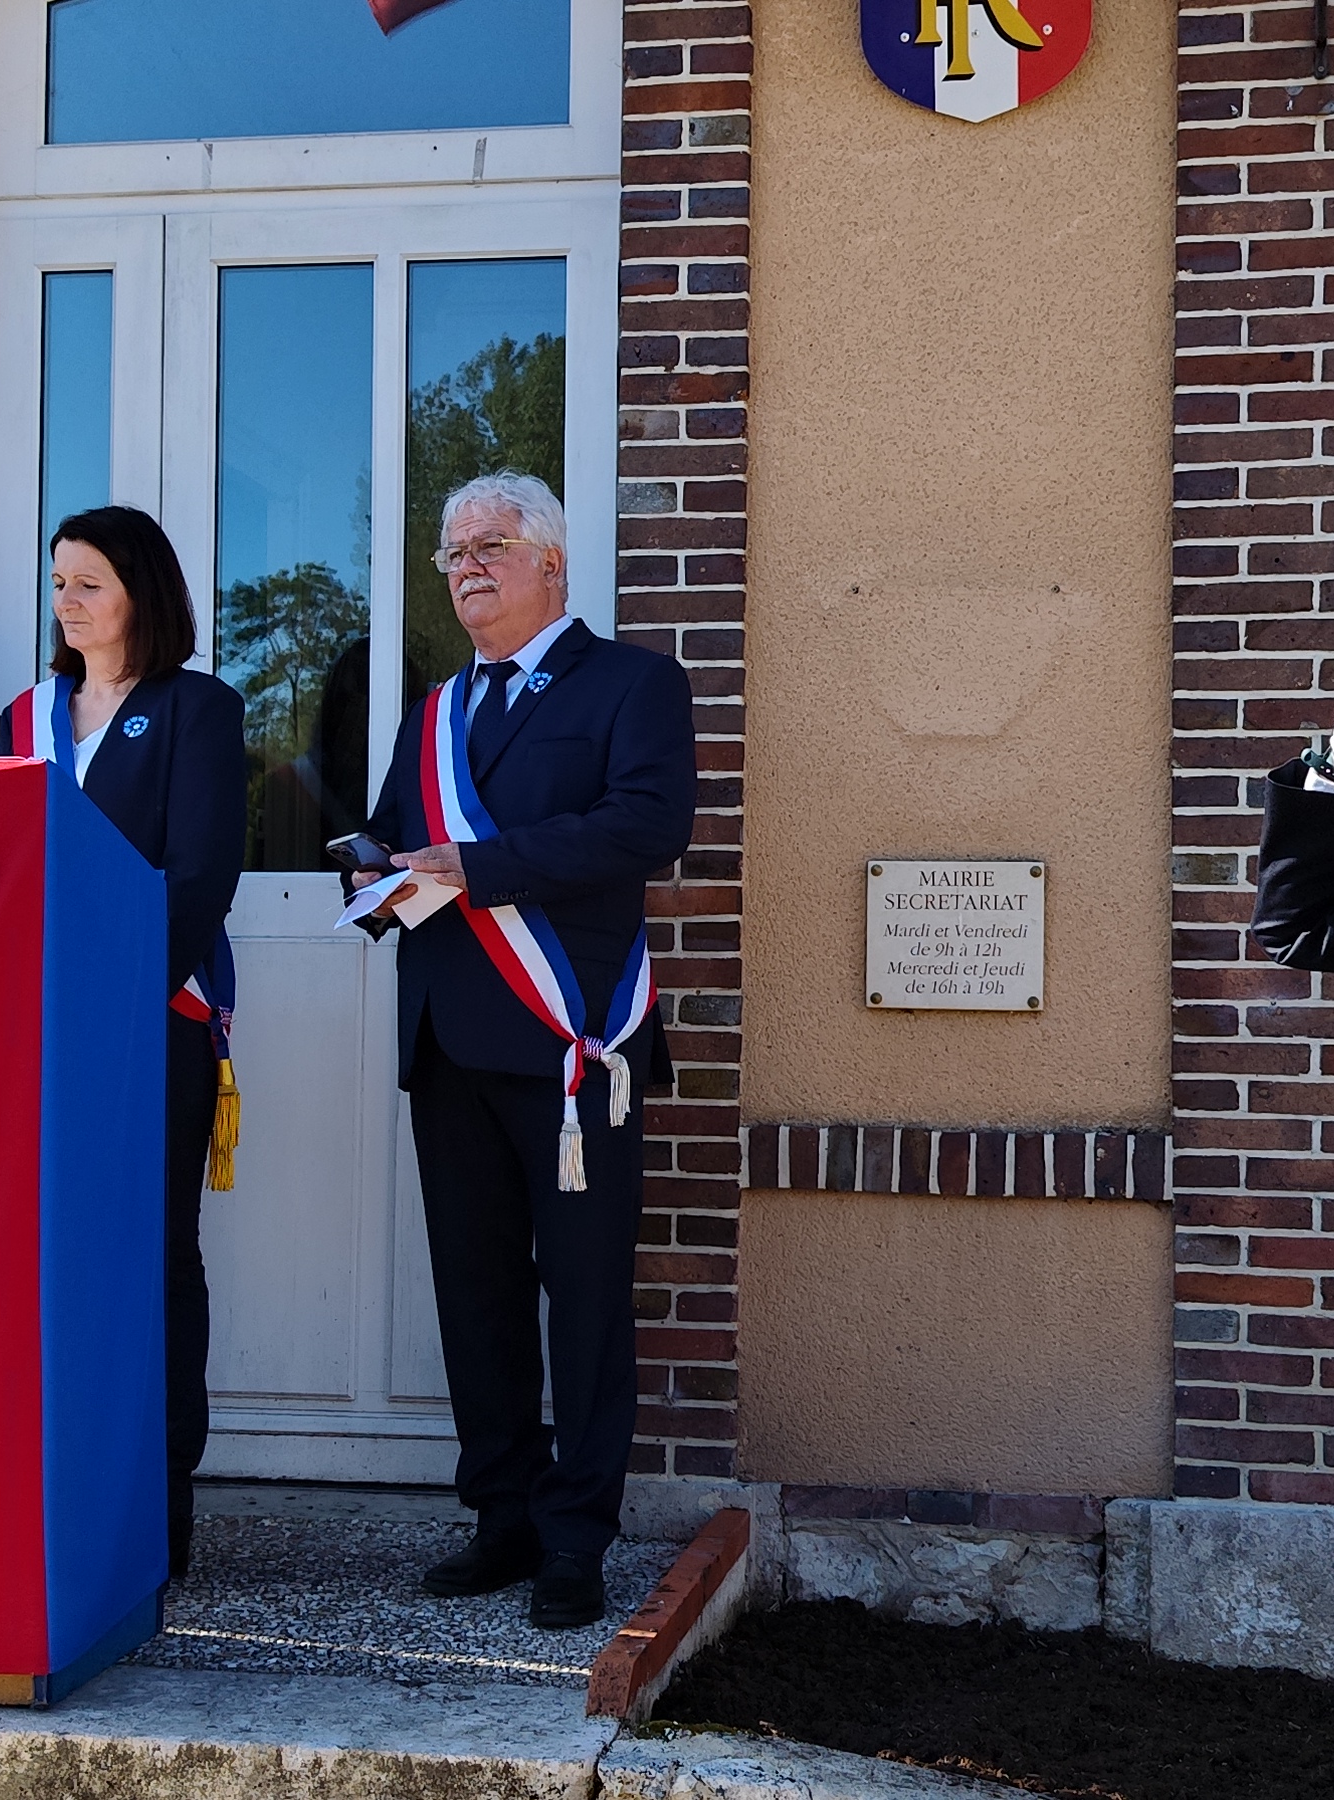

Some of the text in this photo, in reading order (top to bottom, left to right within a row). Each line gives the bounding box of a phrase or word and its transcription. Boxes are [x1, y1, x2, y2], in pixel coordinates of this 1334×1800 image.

[919, 871, 994, 887] MAIRIE
[884, 893, 1028, 910] SECRETARIAT
[883, 924, 1028, 938] Mardi et Vendredi
[910, 942, 1002, 958] de 9h à 12h
[887, 961, 1025, 978] Mercredi et Jeudi
[905, 979, 1004, 995] de 16h à 19h
